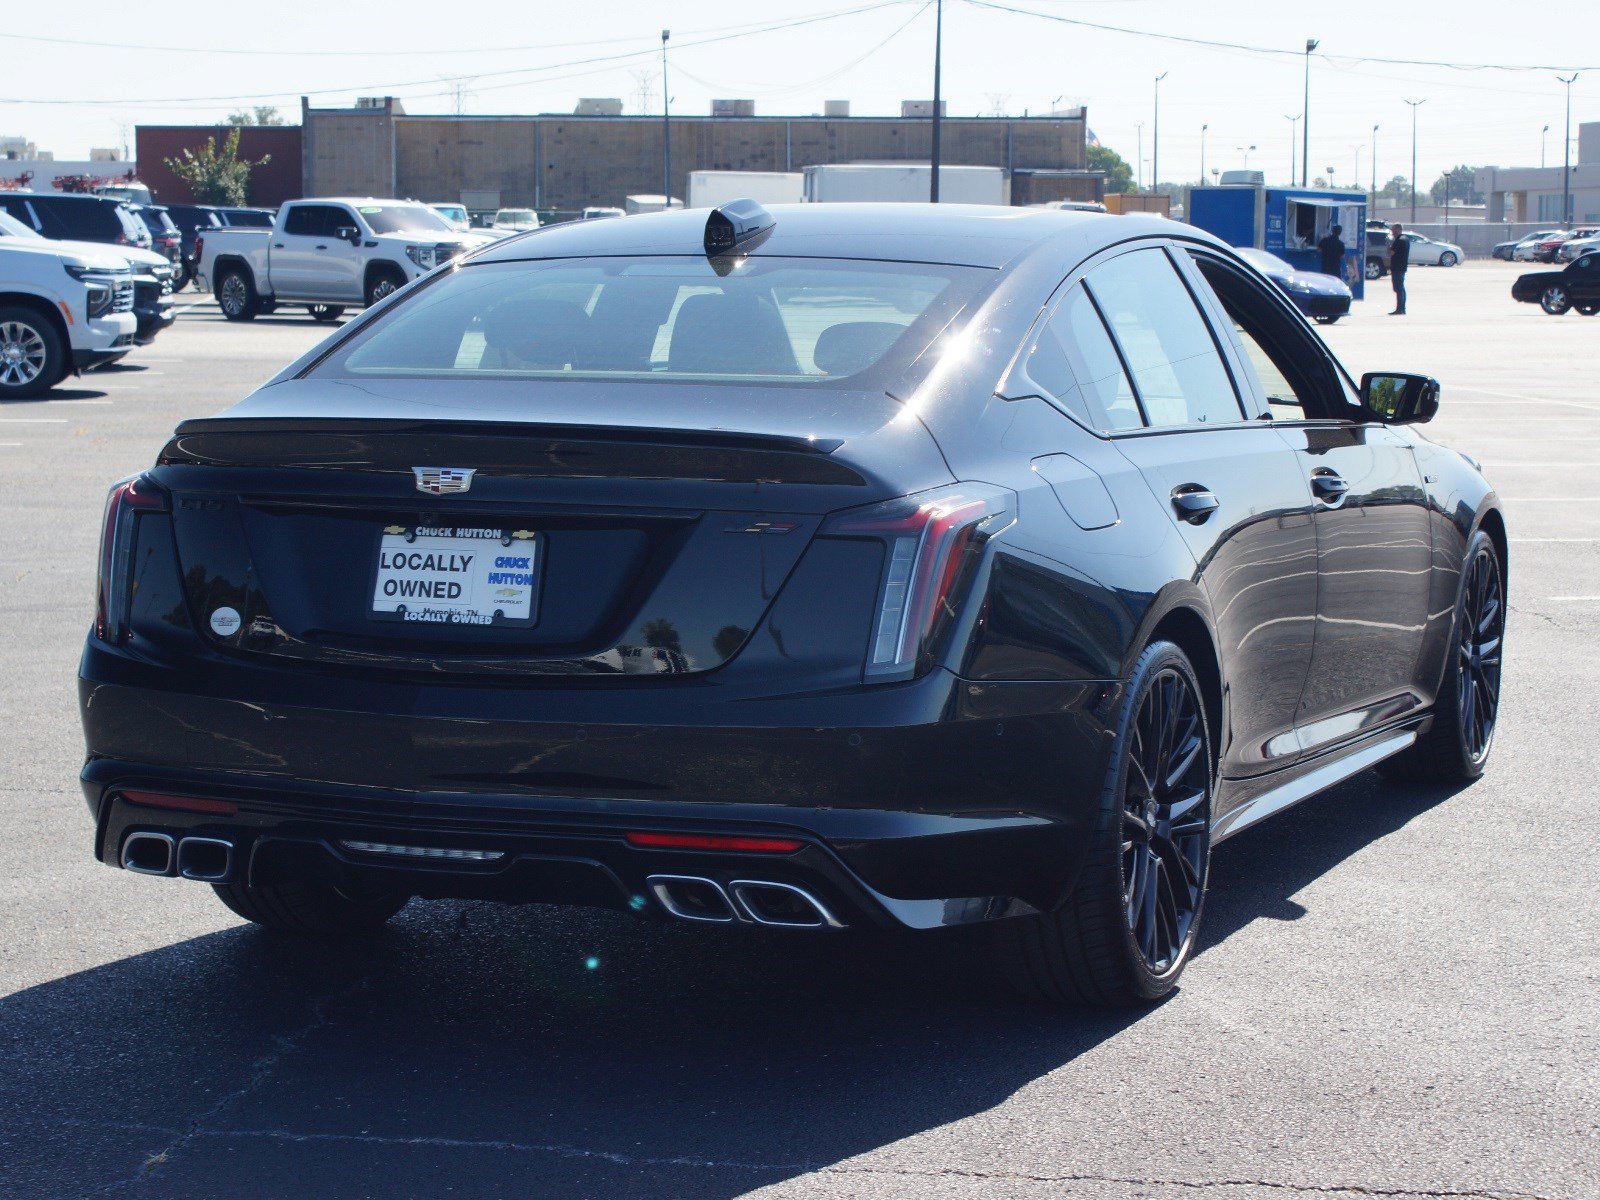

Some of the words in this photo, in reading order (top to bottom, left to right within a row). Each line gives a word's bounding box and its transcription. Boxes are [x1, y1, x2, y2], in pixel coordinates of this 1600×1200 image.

[415, 526, 452, 537] CHUCK
[456, 527, 502, 539] HUTTON
[380, 552, 474, 573] LOCALLY
[494, 556, 530, 570] CHUCK
[487, 572, 534, 586] HUTTON
[383, 578, 462, 600] OWNED
[404, 611, 449, 623] LOCALLY
[451, 614, 493, 625] OWNED
